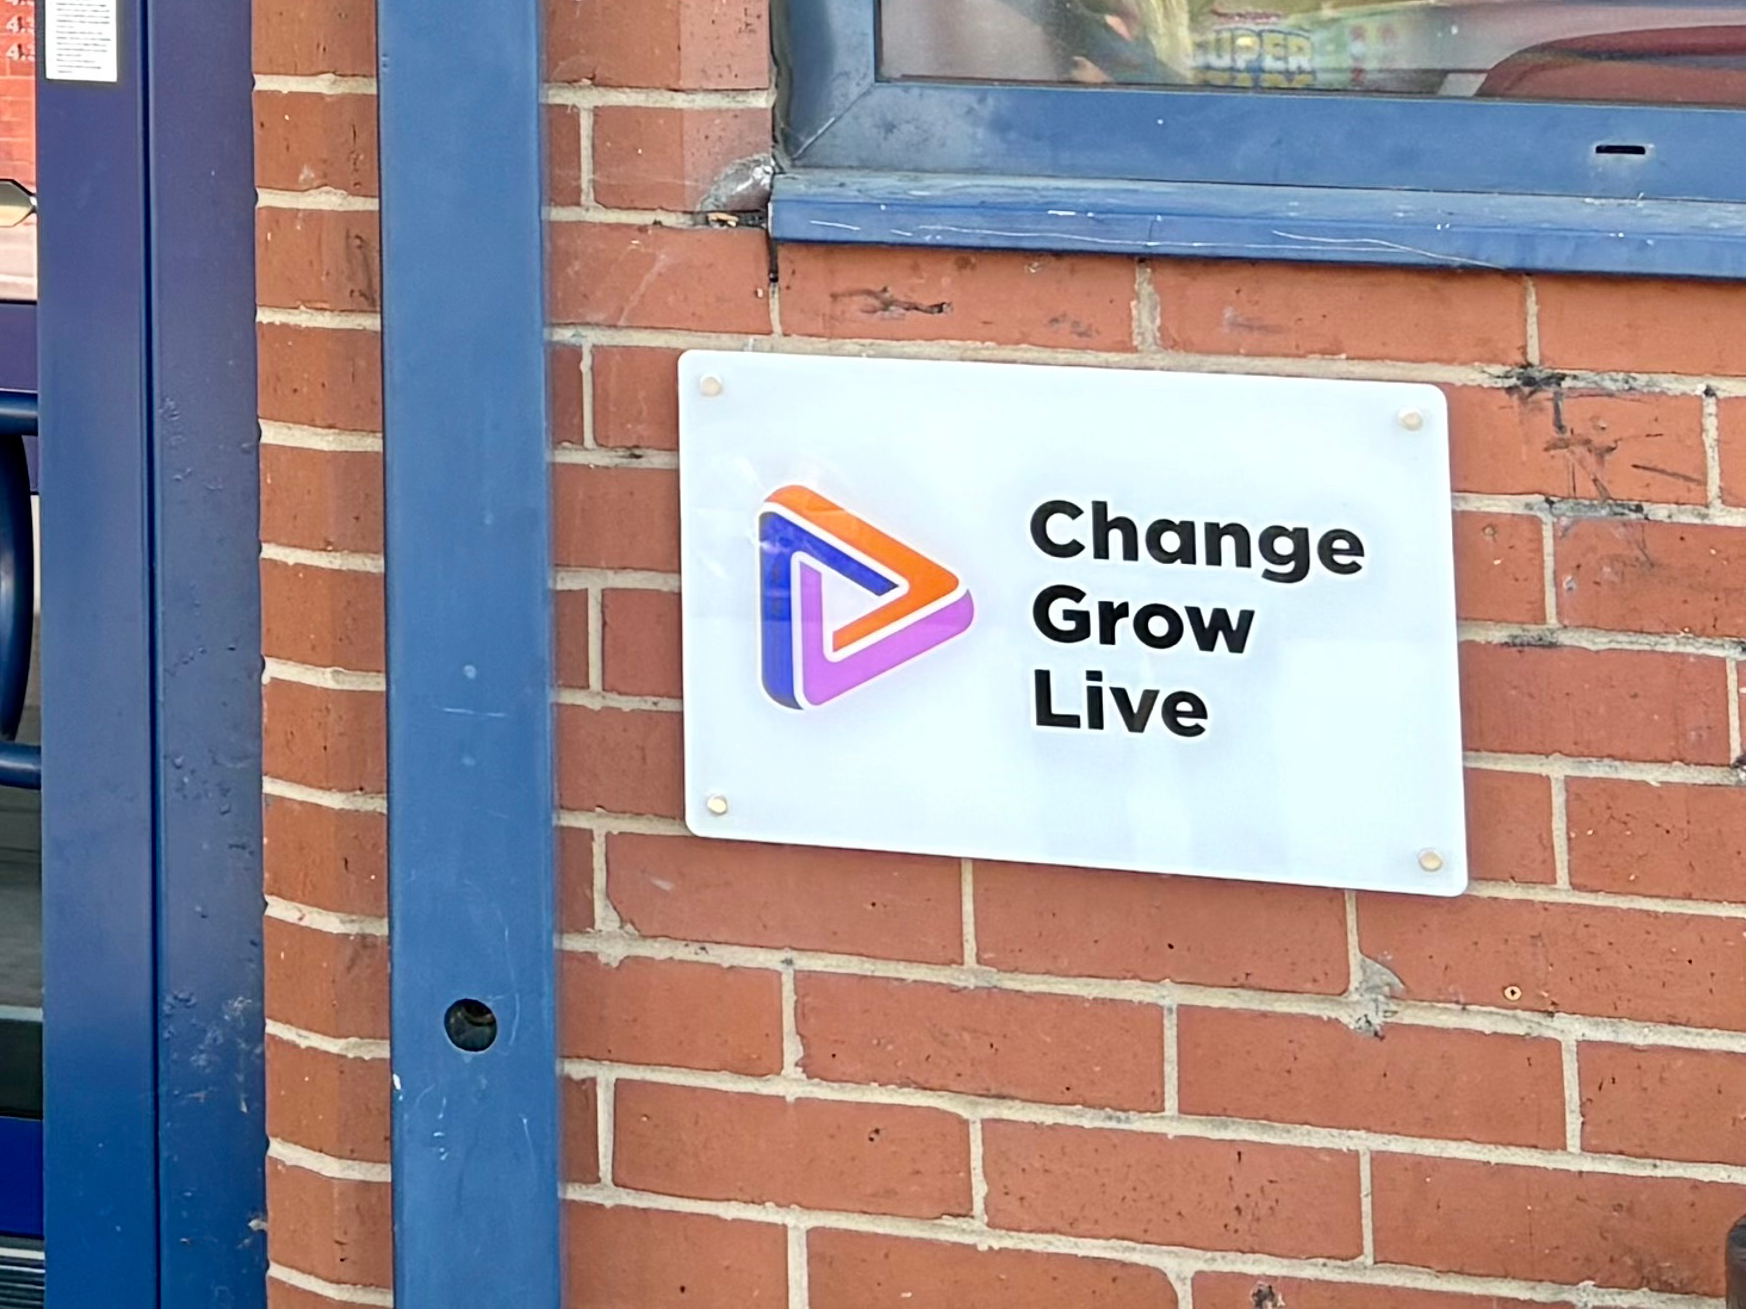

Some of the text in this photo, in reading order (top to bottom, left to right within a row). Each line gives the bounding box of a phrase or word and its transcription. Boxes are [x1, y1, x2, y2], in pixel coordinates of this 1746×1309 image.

[1028, 497, 1367, 586] Change
[1032, 583, 1257, 657] Grow
[1033, 668, 1210, 739] Live
